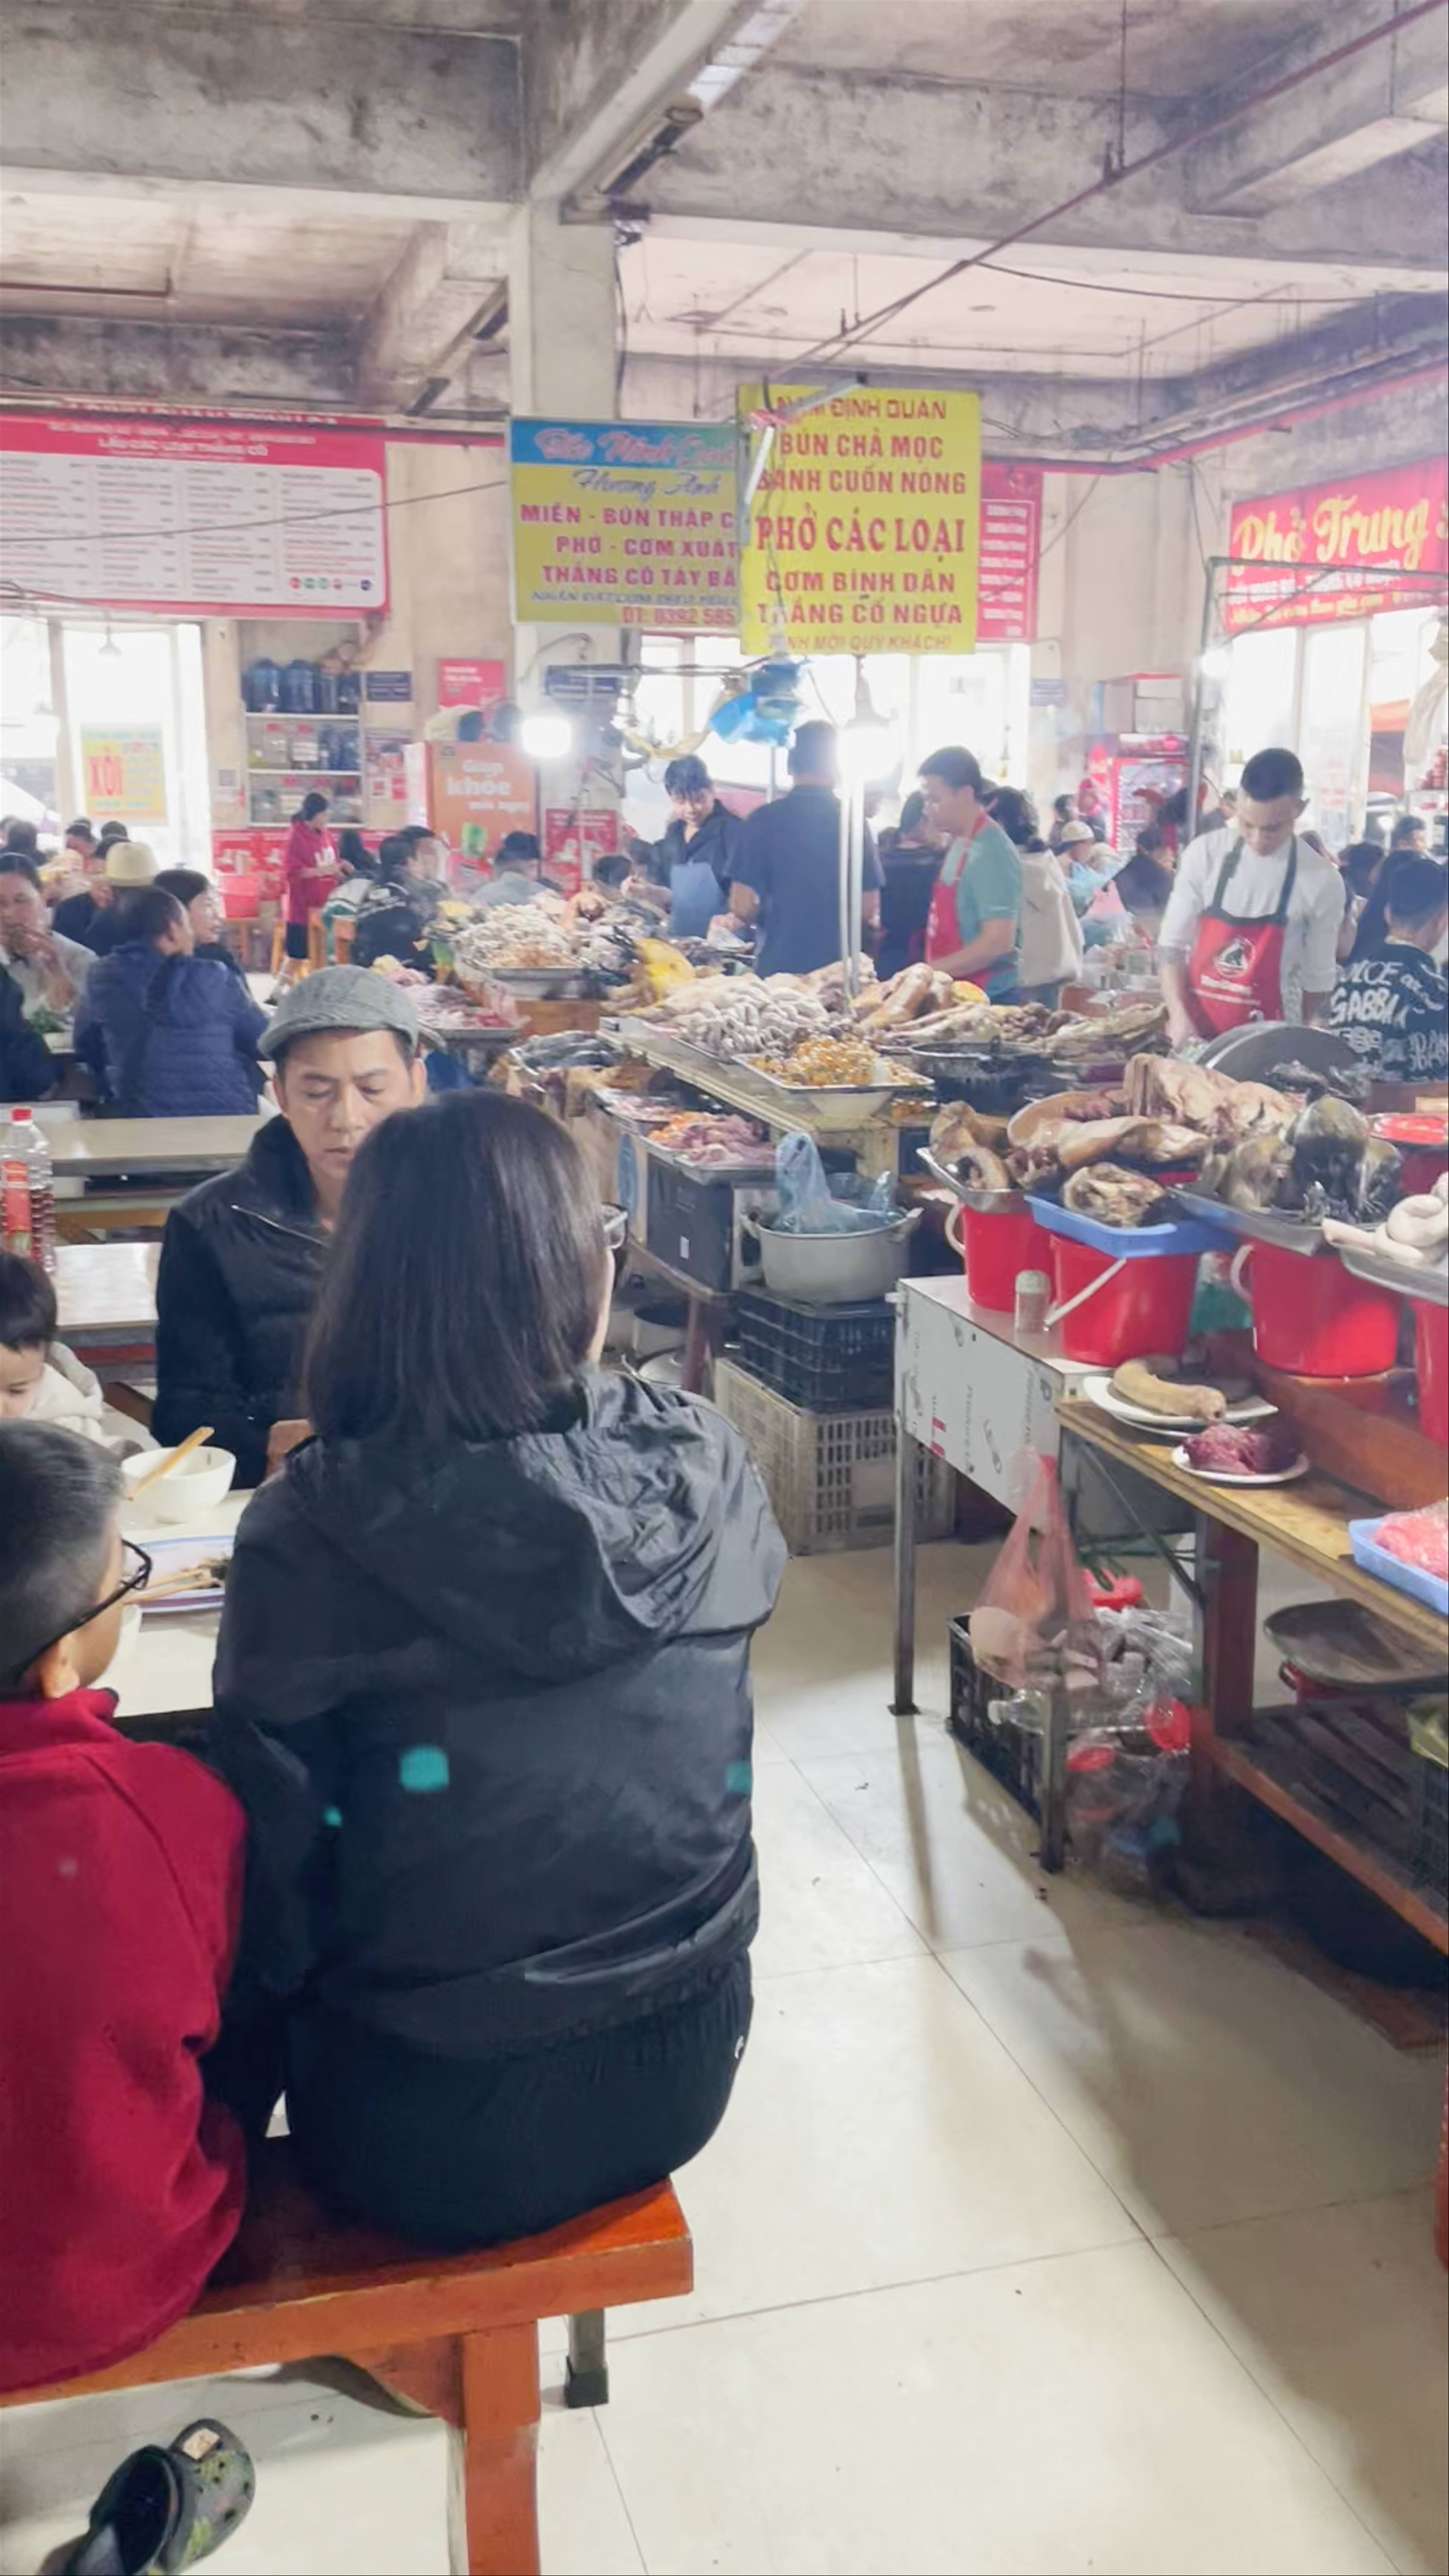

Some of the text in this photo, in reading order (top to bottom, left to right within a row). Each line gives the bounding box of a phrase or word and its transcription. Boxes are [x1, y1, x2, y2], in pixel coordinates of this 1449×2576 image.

[829, 463, 893, 493] CUỐN
[826, 507, 886, 551] CÁC
[895, 518, 965, 562] LOẠI
[1312, 494, 1429, 571] Trung
